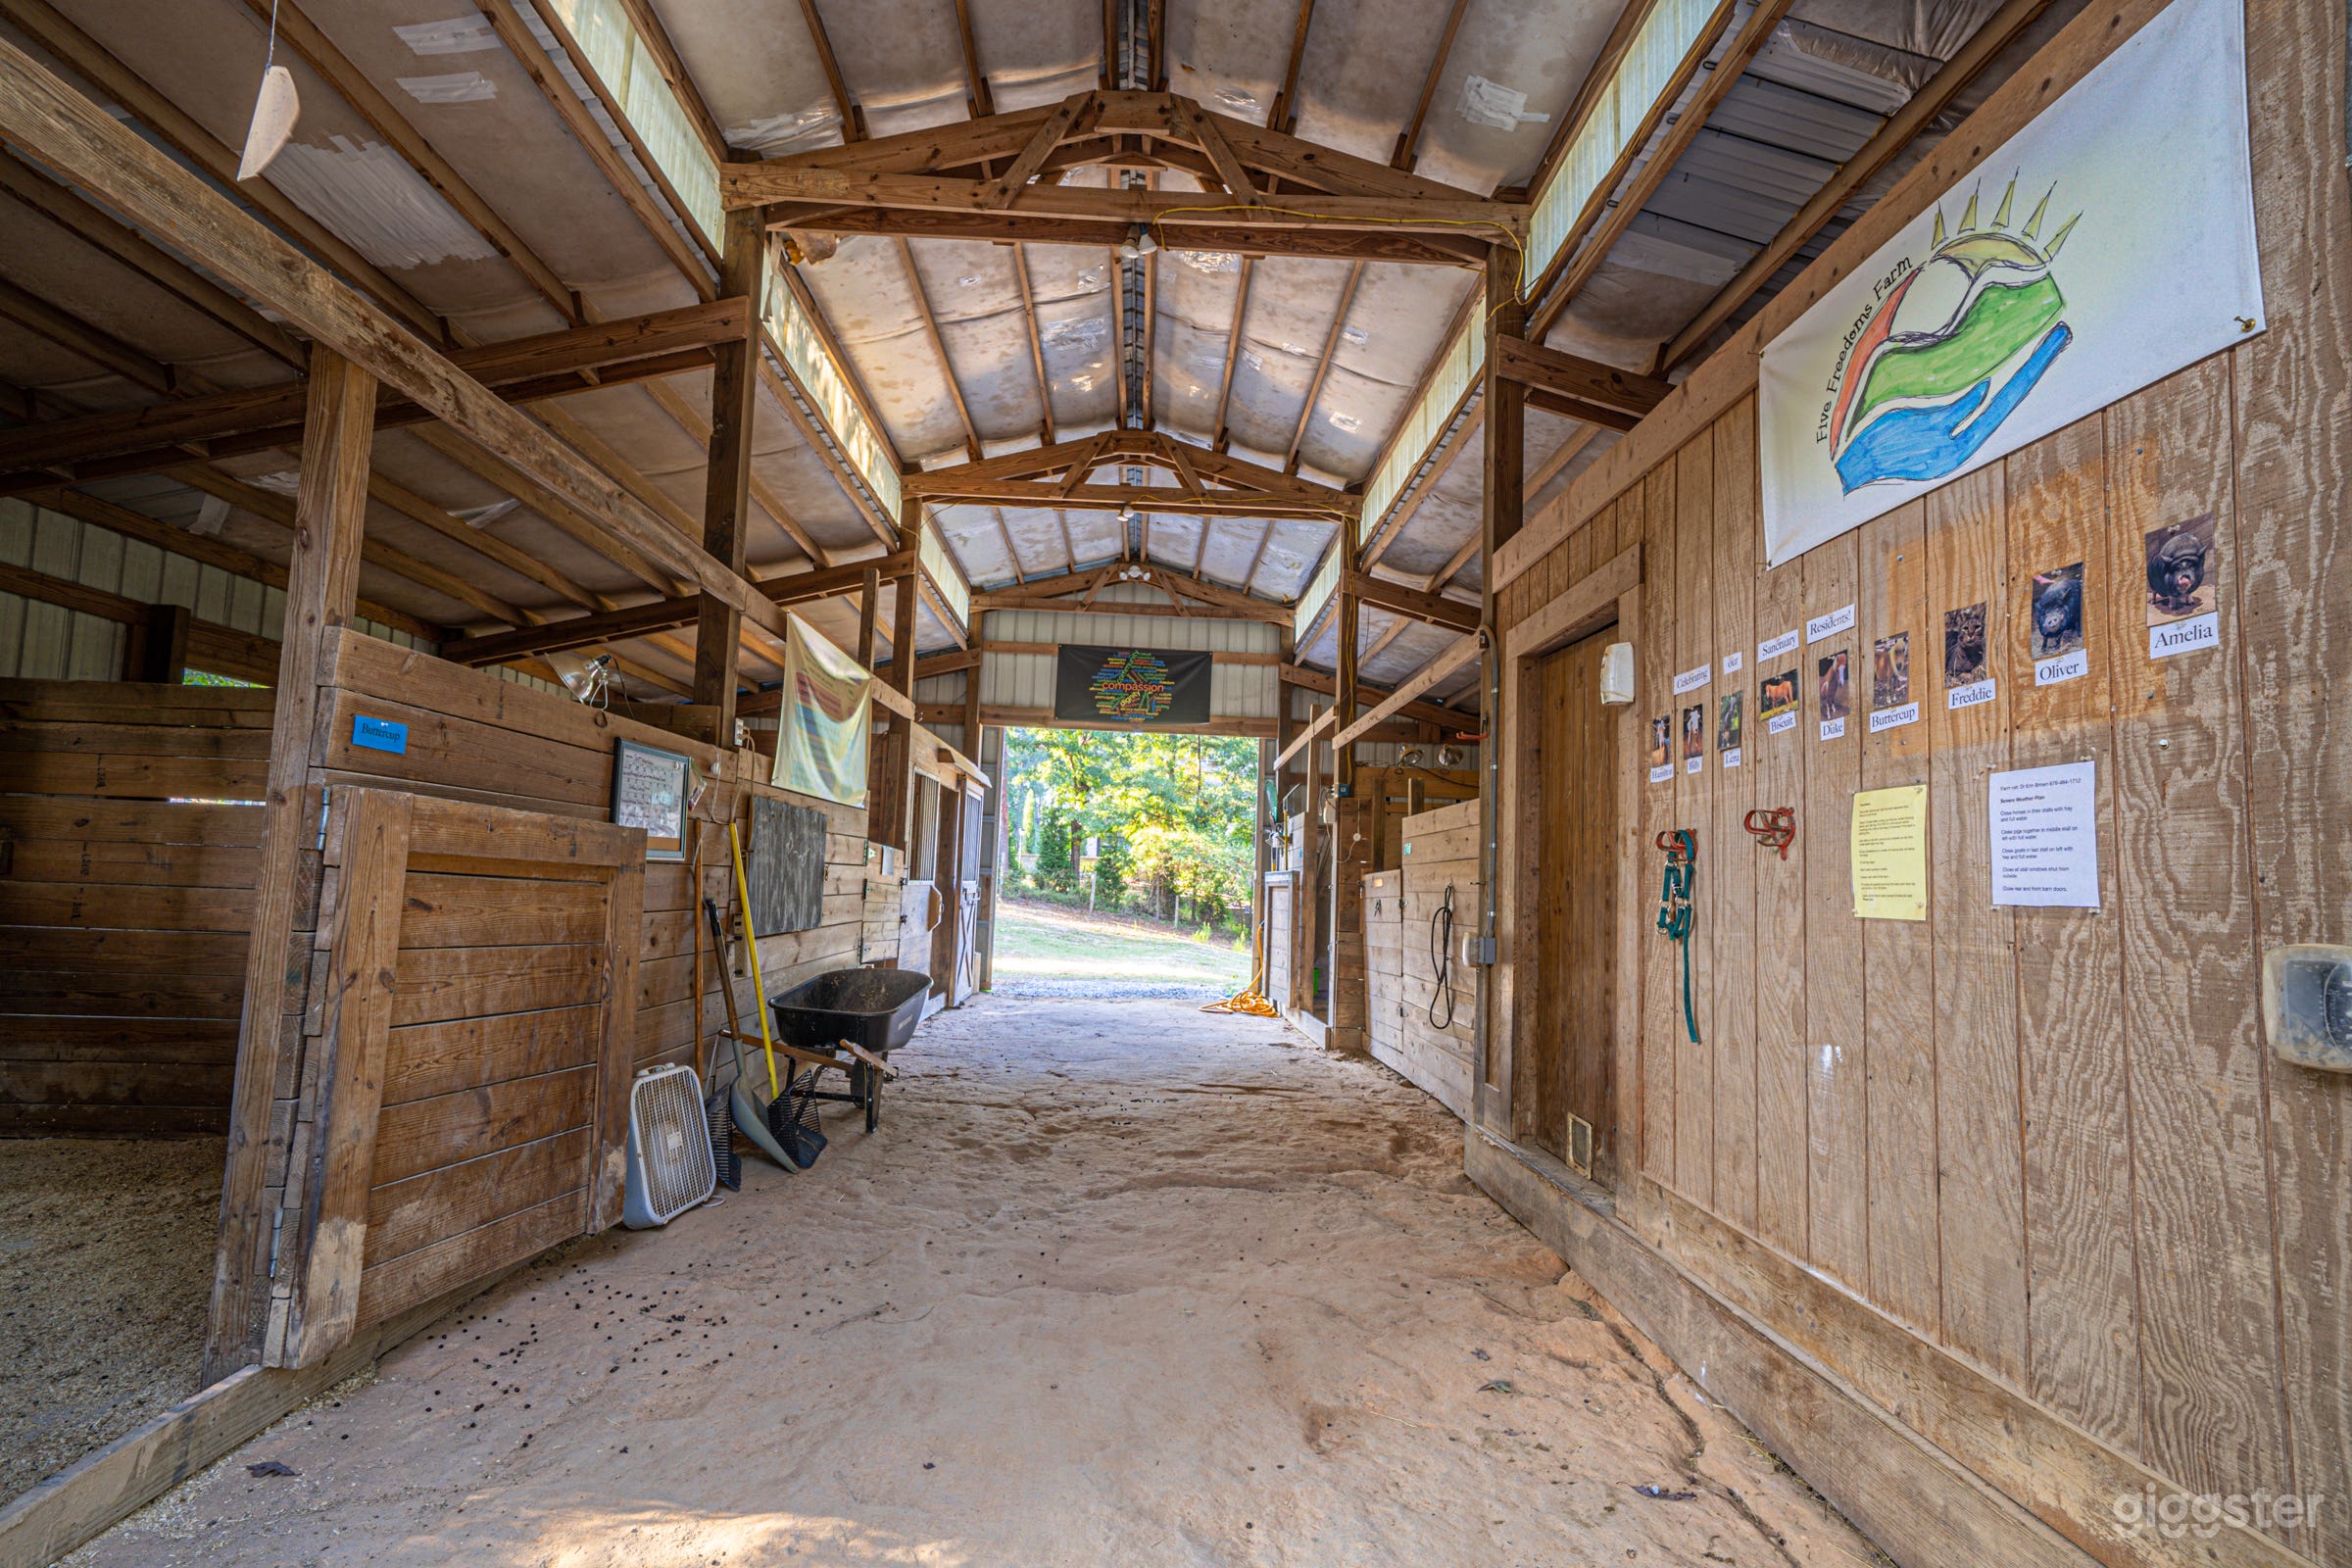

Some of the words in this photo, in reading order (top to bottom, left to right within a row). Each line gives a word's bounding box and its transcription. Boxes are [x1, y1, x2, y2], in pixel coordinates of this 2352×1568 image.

[1817, 402, 1831, 444] Five
[1827, 304, 1872, 393] Freedoms
[1873, 256, 1912, 300] Farm
[2155, 624, 2213, 649] Amelia
[1676, 669, 1709, 689] Celebrating
[1762, 635, 1797, 656] Sanctuary
[1810, 609, 1851, 636] Residents!
[2040, 663, 2080, 681] Oliver
[1102, 682, 1164, 692] compassion
[1120, 691, 1140, 706] dignity
[1951, 688, 1992, 706] Freddie
[1770, 715, 1794, 733] Biscuit
[1871, 707, 1915, 730] Buttercup
[362, 723, 400, 743] Buttercup
[1822, 722, 1843, 737] Duke
